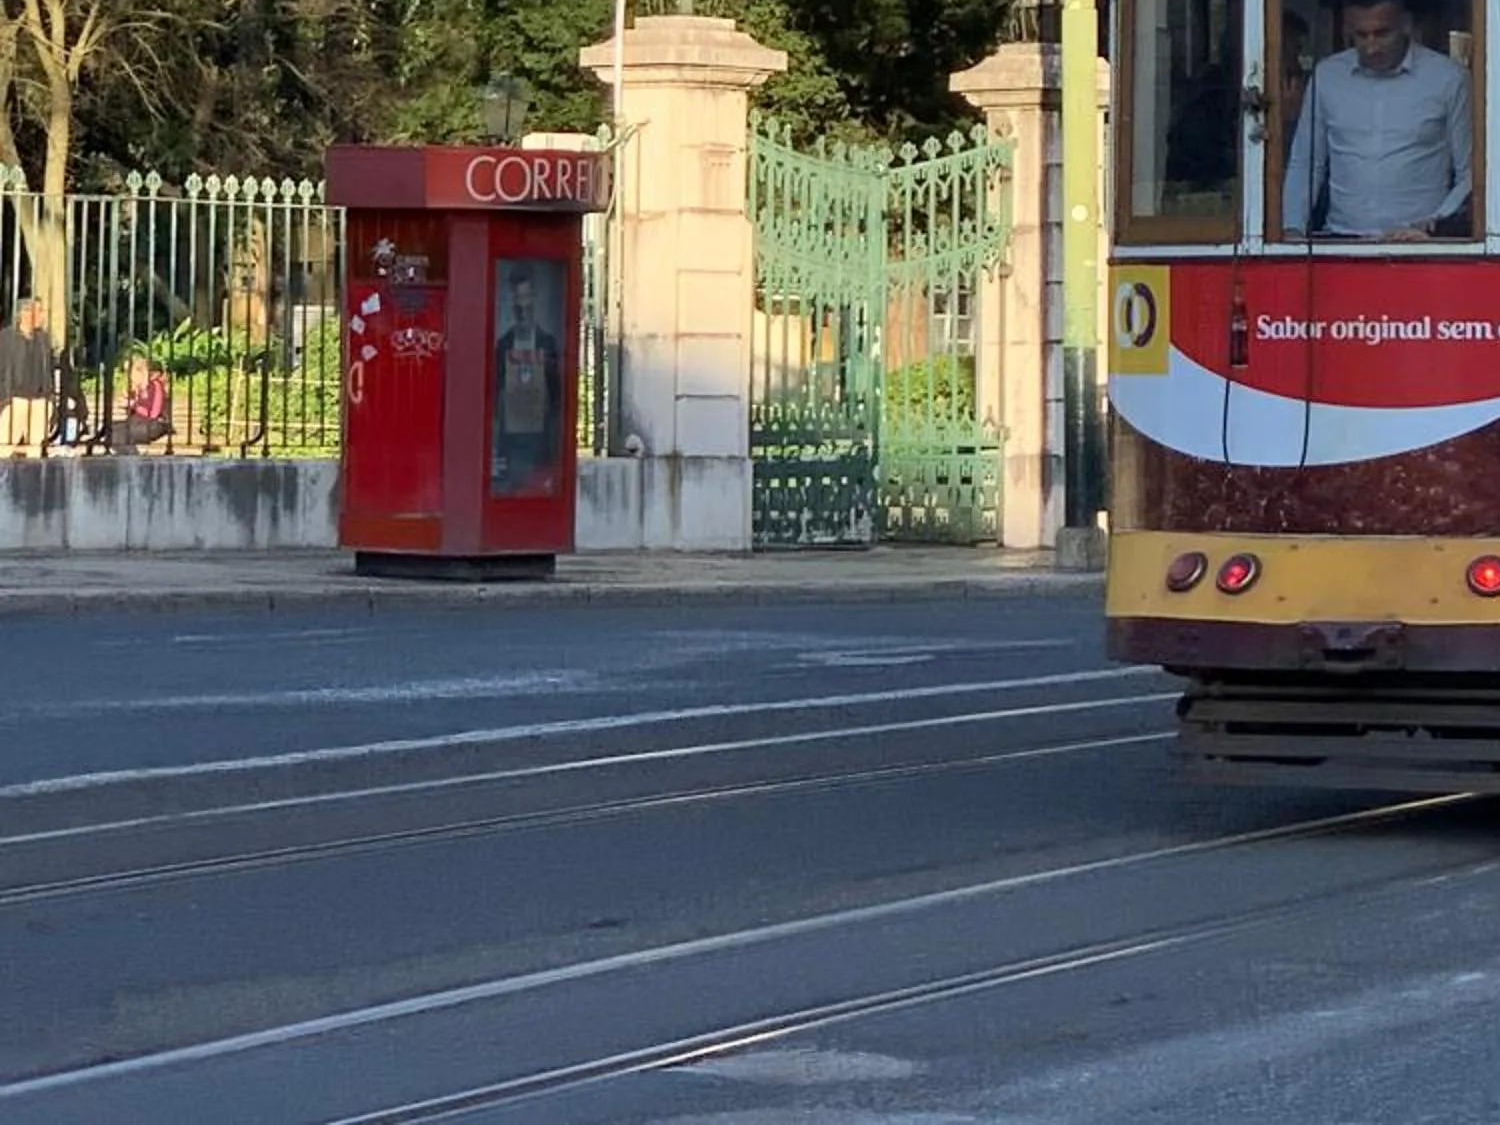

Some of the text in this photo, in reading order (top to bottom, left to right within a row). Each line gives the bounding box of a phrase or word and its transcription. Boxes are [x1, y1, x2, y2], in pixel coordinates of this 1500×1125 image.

[1256, 314, 1327, 340] Sabor
[1330, 314, 1431, 346] original
[1436, 321, 1495, 340] sem
